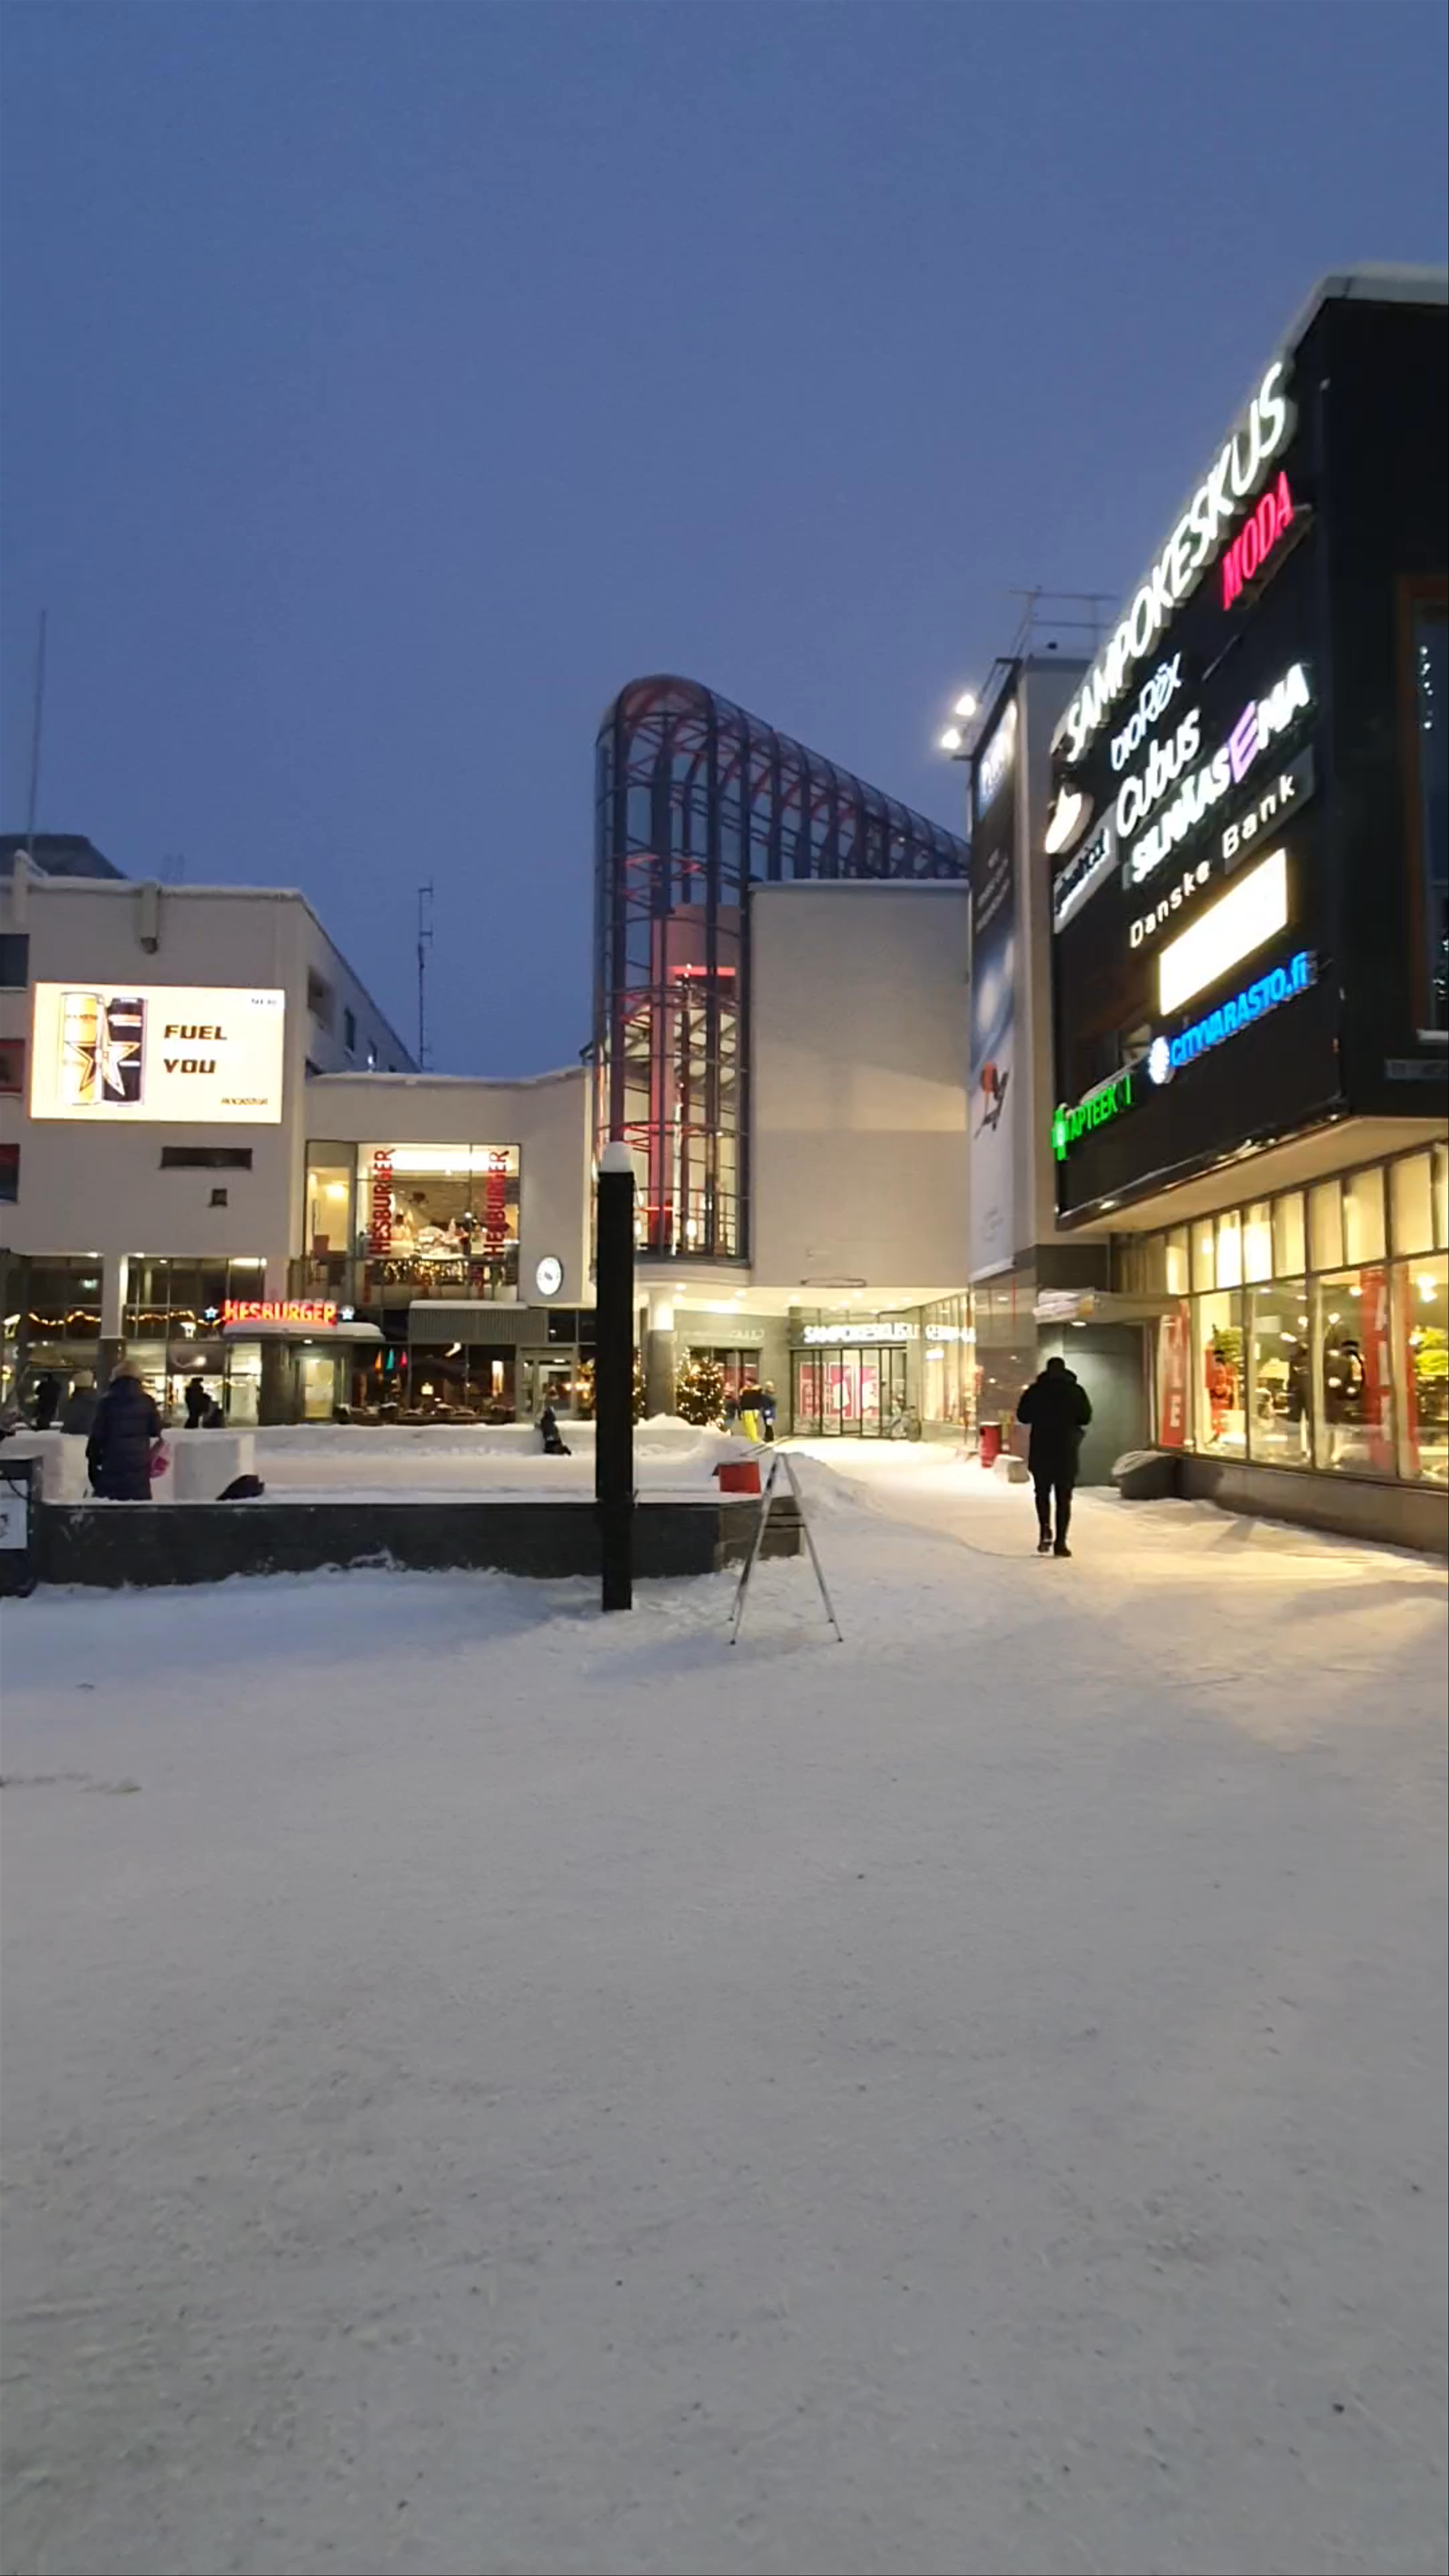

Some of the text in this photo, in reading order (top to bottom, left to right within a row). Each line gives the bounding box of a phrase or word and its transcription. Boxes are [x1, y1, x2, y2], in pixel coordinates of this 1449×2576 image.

[1066, 361, 1285, 762] SAMPOKESKUS
[1223, 471, 1294, 611] MODA
[1130, 861, 1210, 948] Danske
[1222, 775, 1295, 859] Bank
[164, 1024, 228, 1040] FUEL
[164, 1058, 216, 1073] YOU
[224, 1300, 335, 1324] HESBURGER
